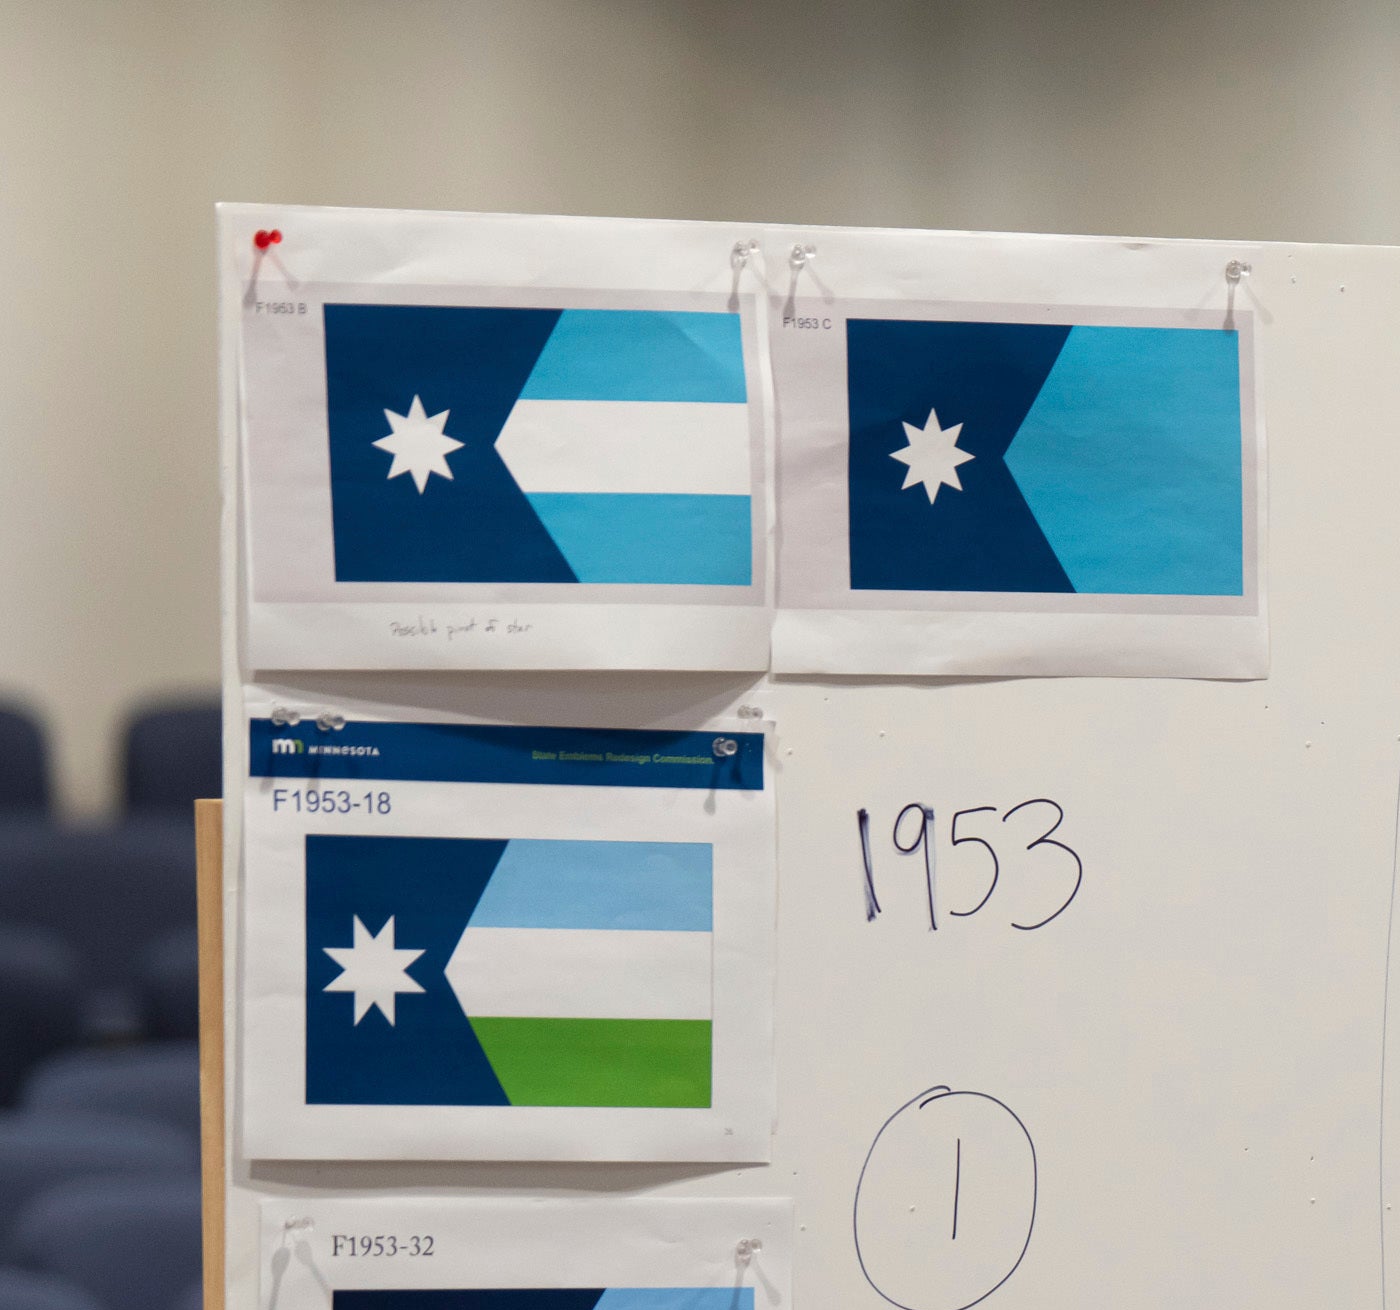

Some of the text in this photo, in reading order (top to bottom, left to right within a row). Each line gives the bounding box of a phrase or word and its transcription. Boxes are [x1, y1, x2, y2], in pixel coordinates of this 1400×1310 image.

[783, 317, 832, 330] F1953 C
[532, 750, 556, 760] State
[559, 751, 602, 761] Emblems
[606, 752, 650, 765] Redesign
[273, 789, 391, 815] F1953-18
[857, 799, 1082, 932] 1953
[951, 1138, 961, 1240] 1
[331, 1234, 435, 1256] F1953-32
